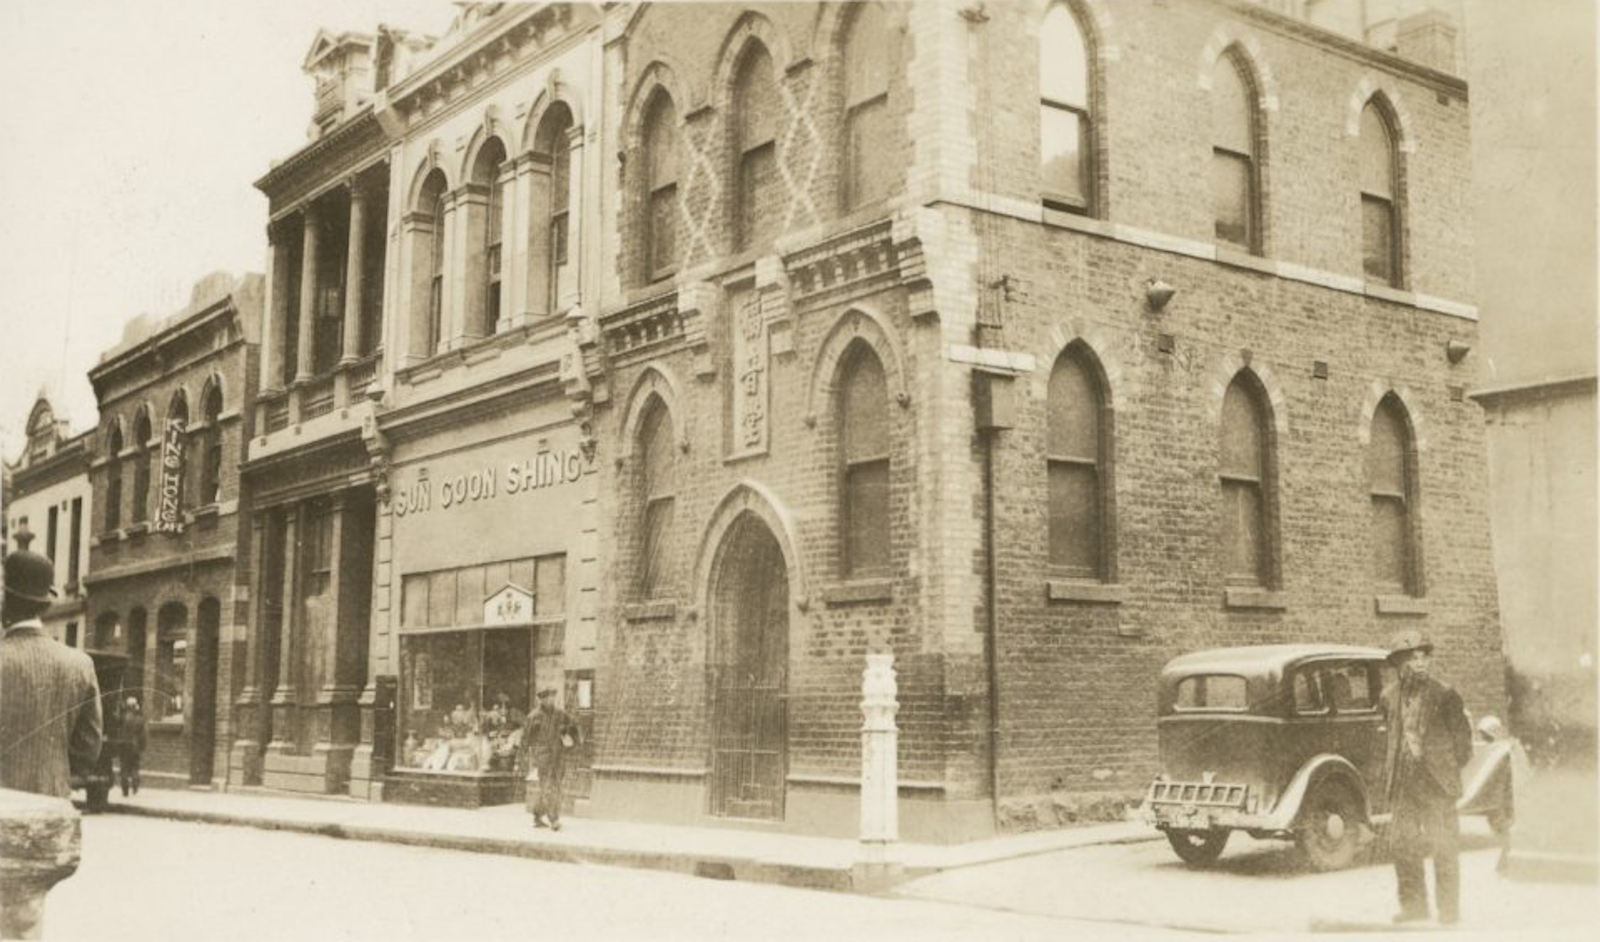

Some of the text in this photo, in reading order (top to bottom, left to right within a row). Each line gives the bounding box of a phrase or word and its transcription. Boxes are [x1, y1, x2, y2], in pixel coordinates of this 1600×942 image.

[161, 418, 185, 522] KING HONG
[394, 479, 433, 518] SUN
[505, 449, 583, 495] SHING
